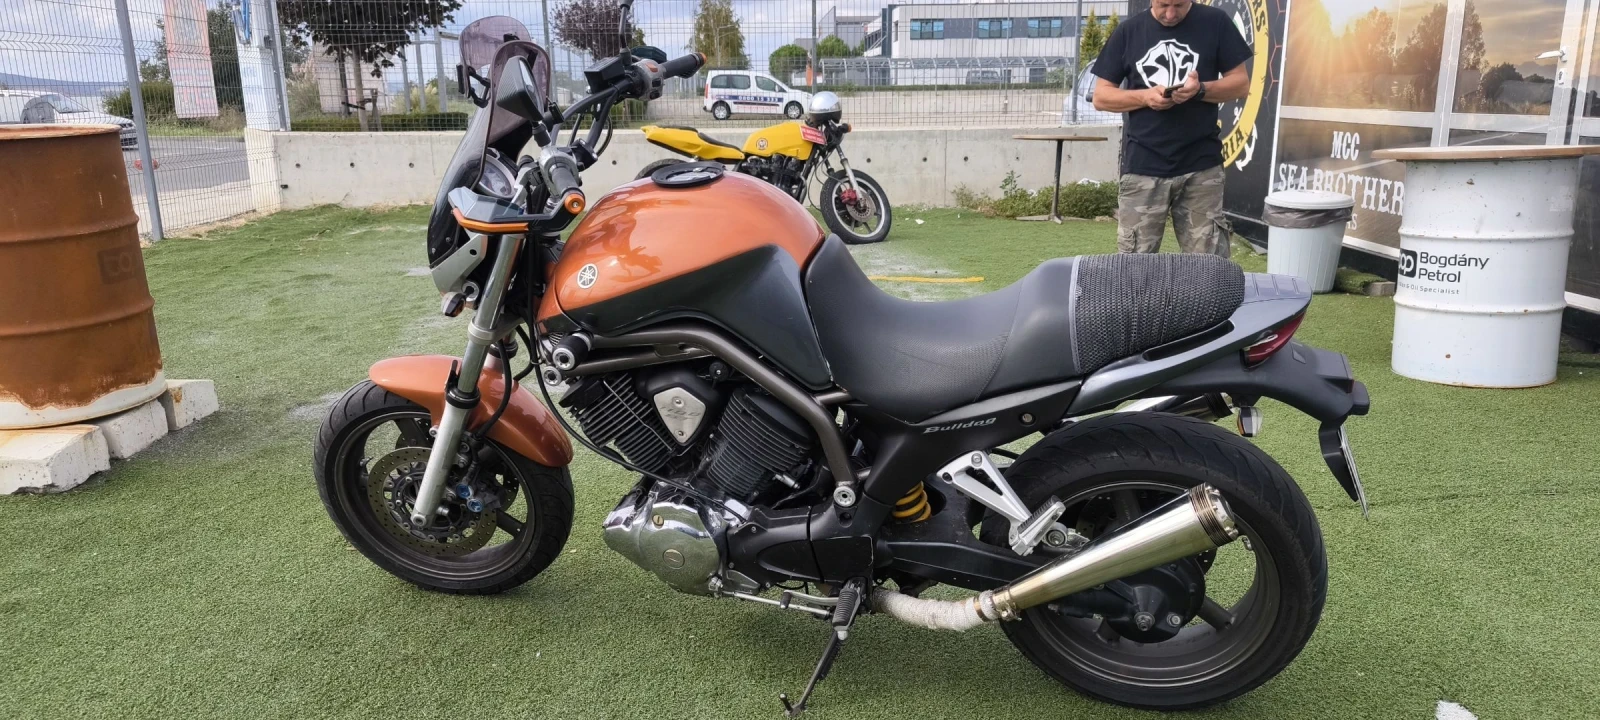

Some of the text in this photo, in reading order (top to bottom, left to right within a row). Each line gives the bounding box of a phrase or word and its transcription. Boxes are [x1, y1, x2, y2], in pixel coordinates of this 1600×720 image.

[1331, 131, 1360, 161] MCC
[1278, 163, 1309, 191] SEA
[1420, 252, 1490, 270] Bogdány
[1418, 268, 1461, 283] Petrol
[1419, 286, 1460, 295] Specialist
[923, 417, 997, 434] Bulldog
